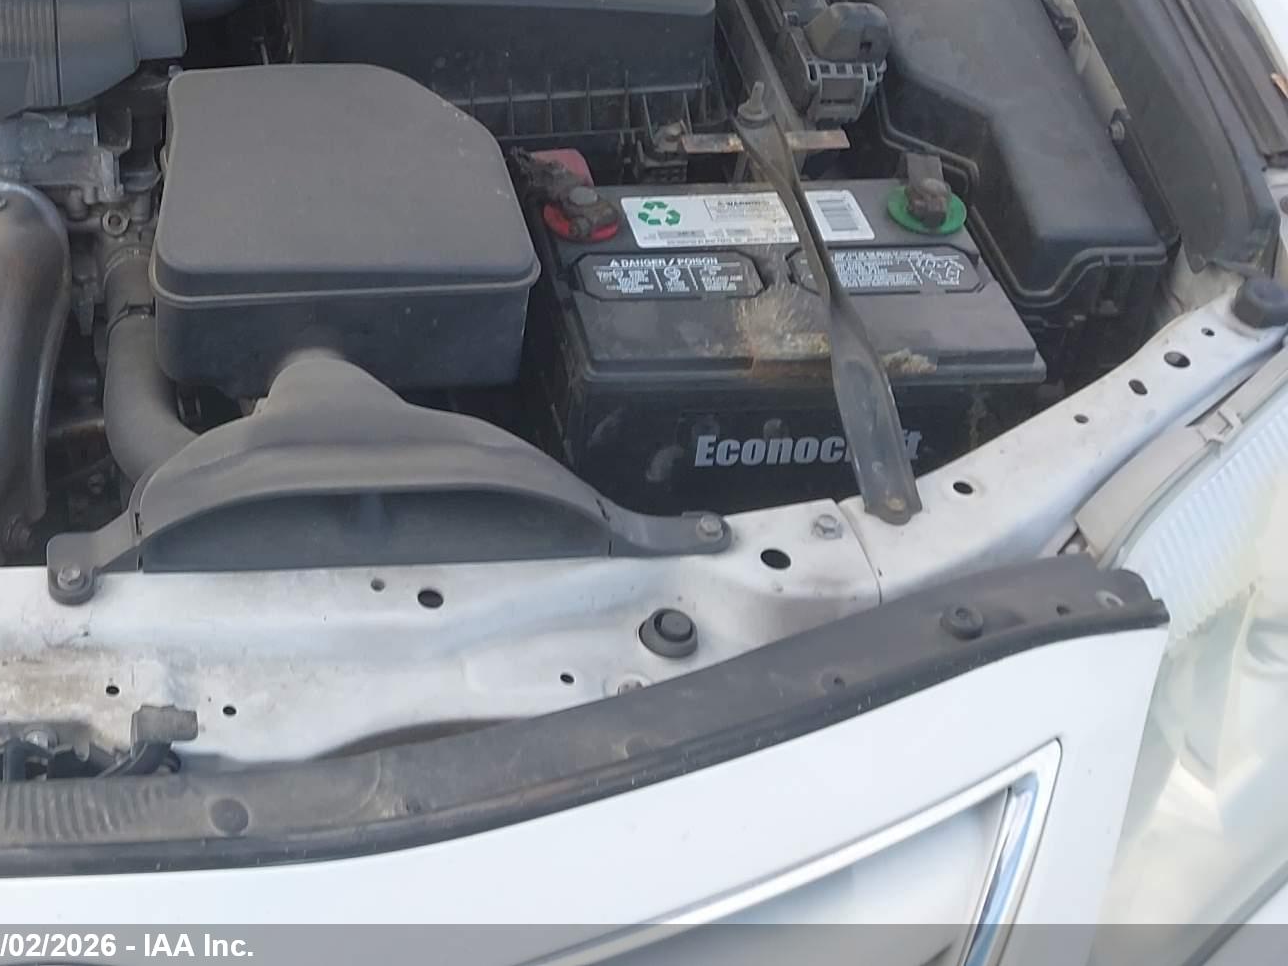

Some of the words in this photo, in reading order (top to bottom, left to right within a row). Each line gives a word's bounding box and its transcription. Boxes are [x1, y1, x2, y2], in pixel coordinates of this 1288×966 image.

[621, 258, 666, 267] DANGER
[677, 256, 718, 266] POISON
[695, 430, 923, 467] Econoct
